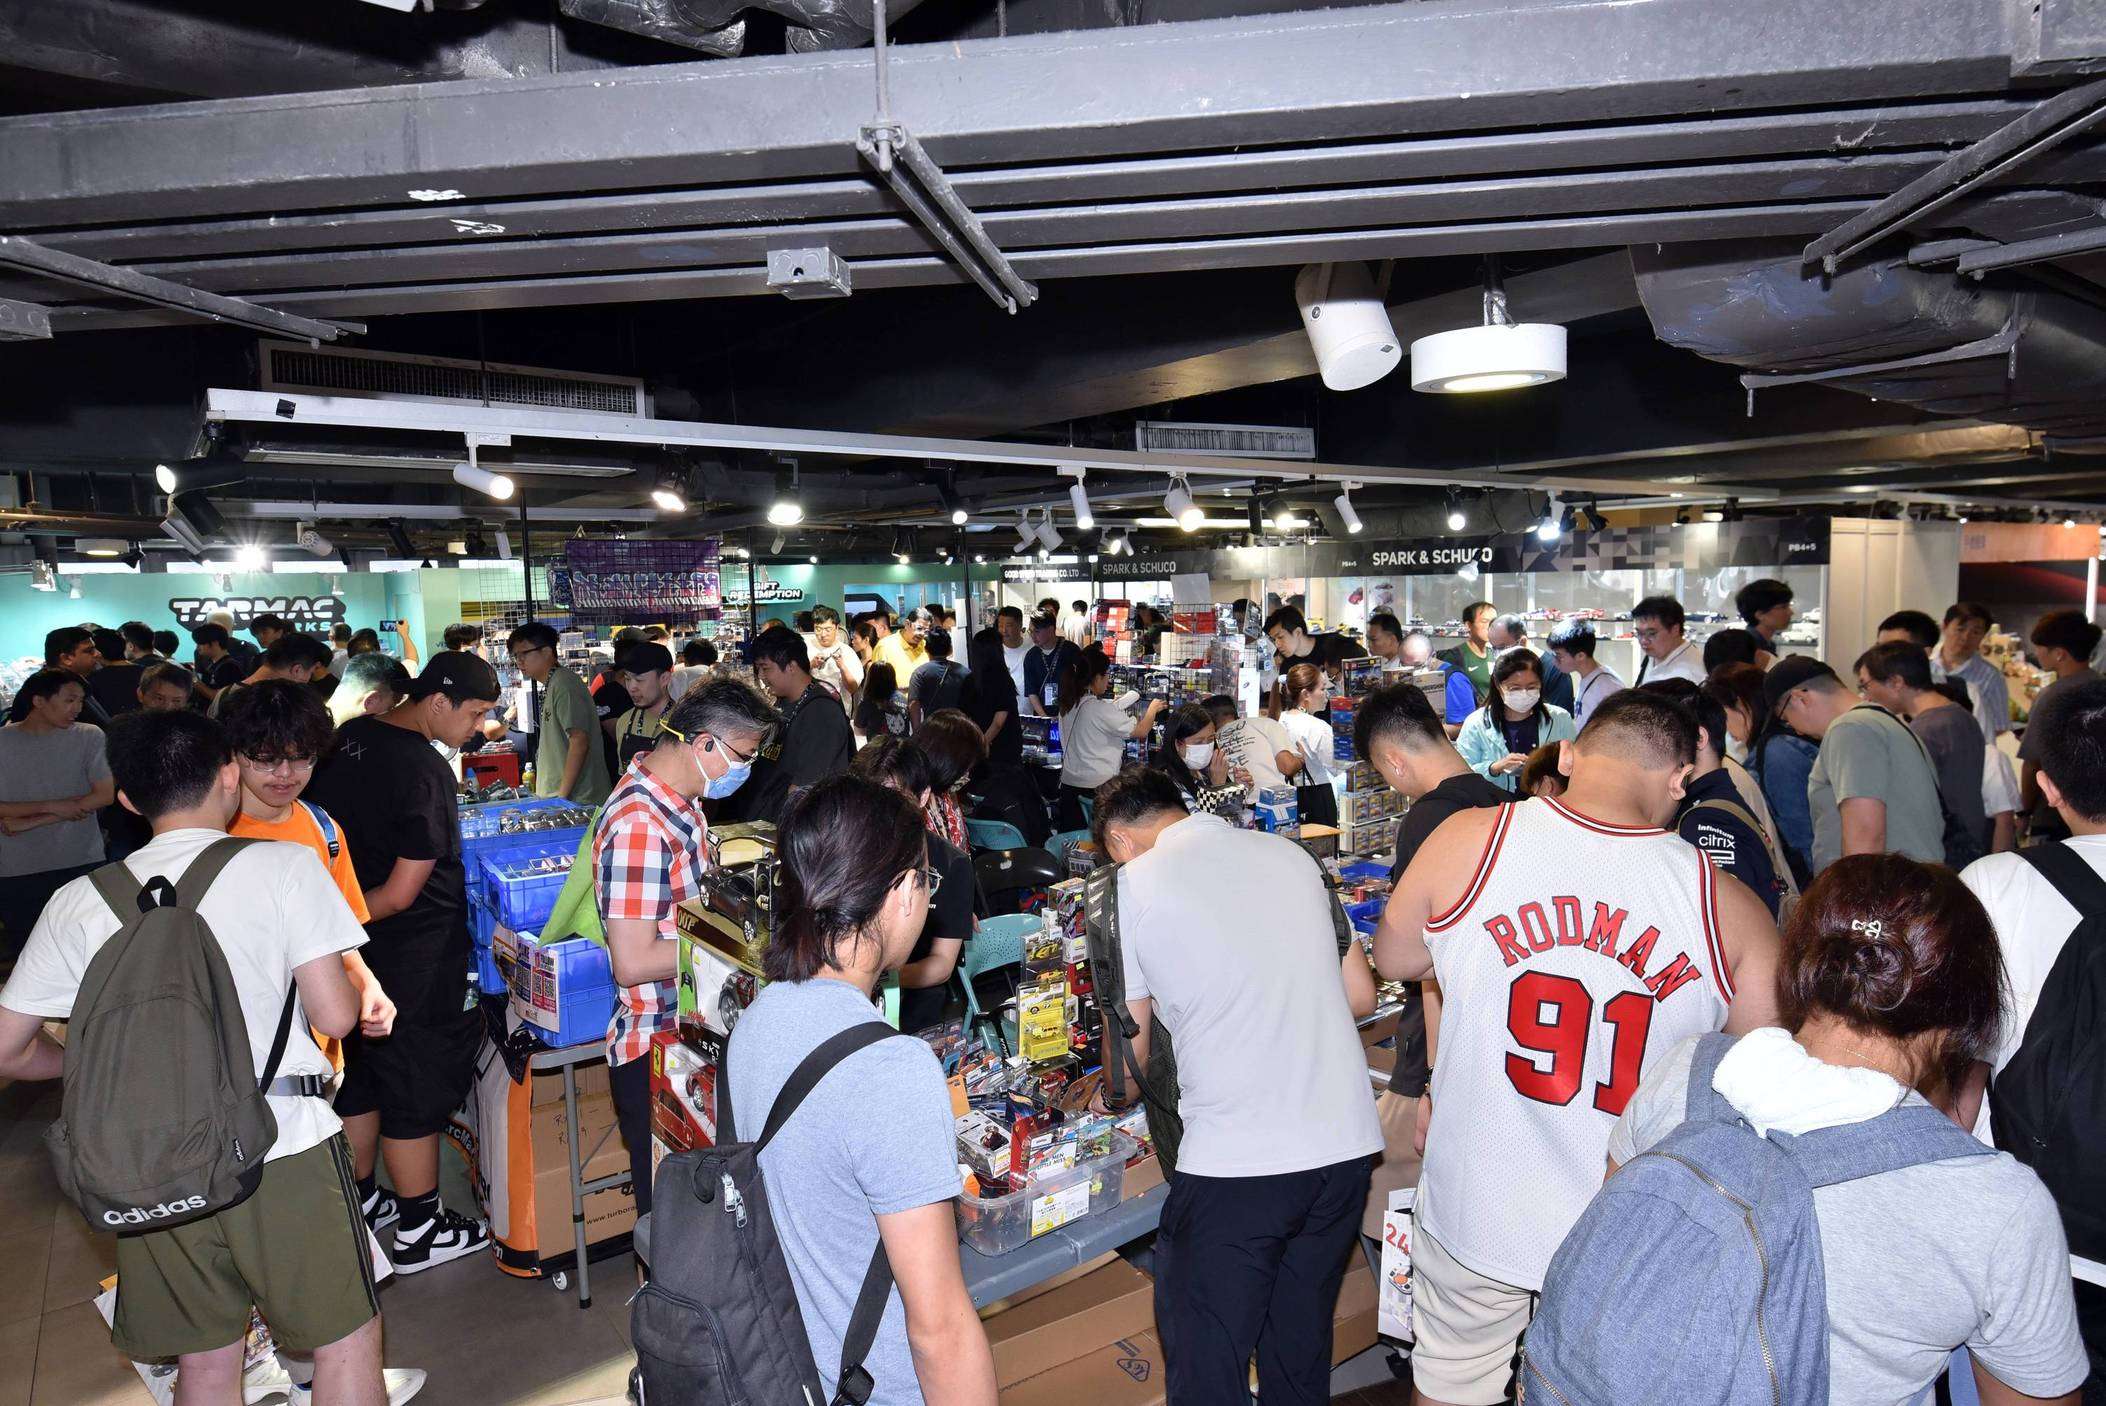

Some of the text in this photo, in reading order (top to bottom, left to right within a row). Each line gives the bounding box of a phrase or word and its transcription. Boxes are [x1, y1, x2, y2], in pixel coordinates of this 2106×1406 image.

[1372, 551, 1417, 566] SPARK
[1420, 550, 1429, 565] &
[1102, 561, 1176, 575] SPARK & SCHUCO
[173, 599, 334, 622] TARMAC
[1697, 824, 1735, 840] Infinitum
[1698, 834, 1736, 849] citrix
[1482, 895, 1703, 1003] RODMAN
[1505, 969, 1655, 1117] 91
[104, 1195, 207, 1225] adidas
[586, 1206, 636, 1225] www.turbora
